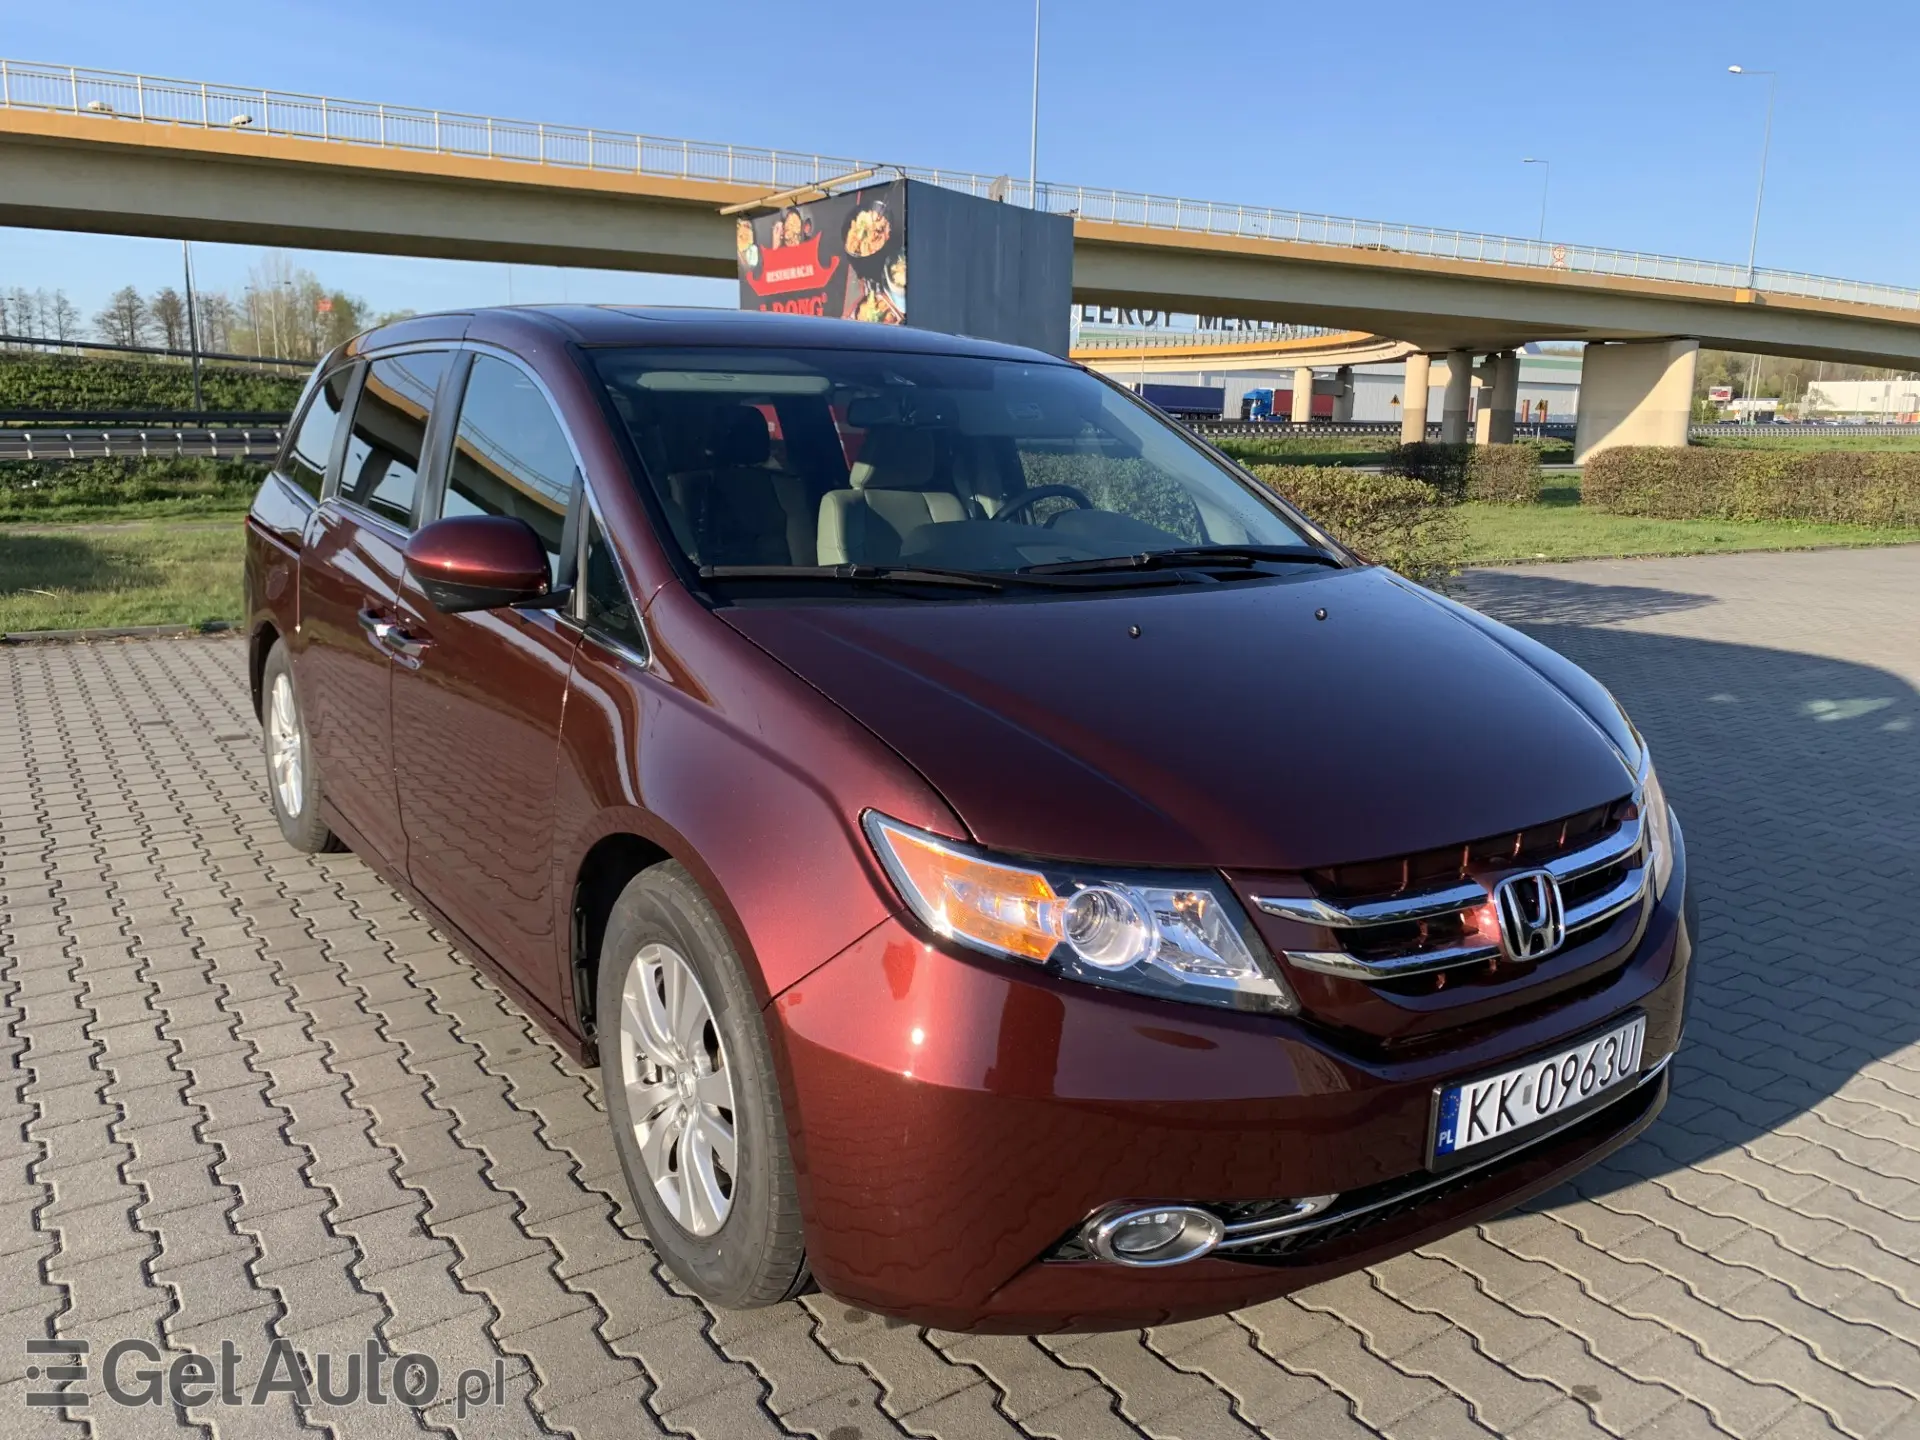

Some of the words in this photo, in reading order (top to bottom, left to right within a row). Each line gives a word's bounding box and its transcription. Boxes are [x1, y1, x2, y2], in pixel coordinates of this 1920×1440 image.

[1467, 1073, 1524, 1142] KK
[1535, 1024, 1639, 1115] 0963U
[1439, 1129, 1454, 1147] PL
